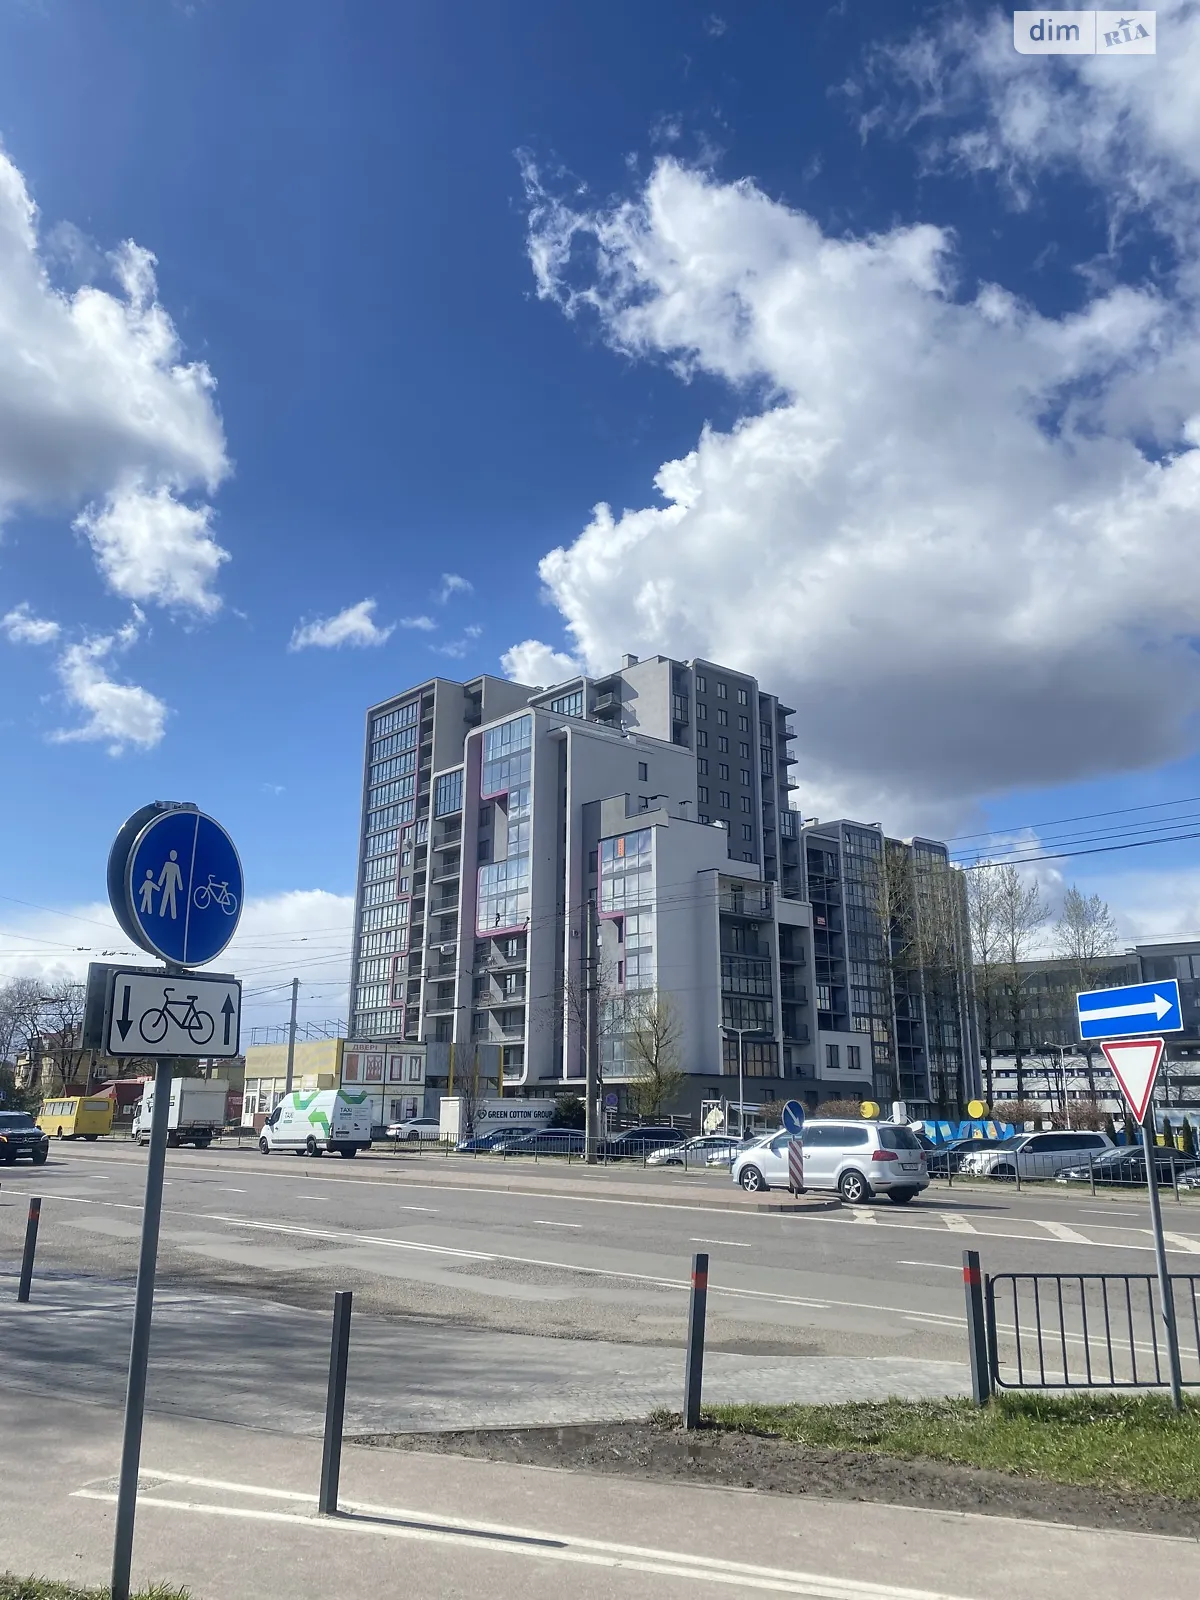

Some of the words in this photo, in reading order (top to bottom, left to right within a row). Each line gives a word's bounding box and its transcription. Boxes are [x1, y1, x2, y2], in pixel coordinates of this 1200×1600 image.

[488, 1110, 508, 1119] GREEN
[509, 1110, 532, 1119] COTTON
[533, 1110, 553, 1119] GROUP
